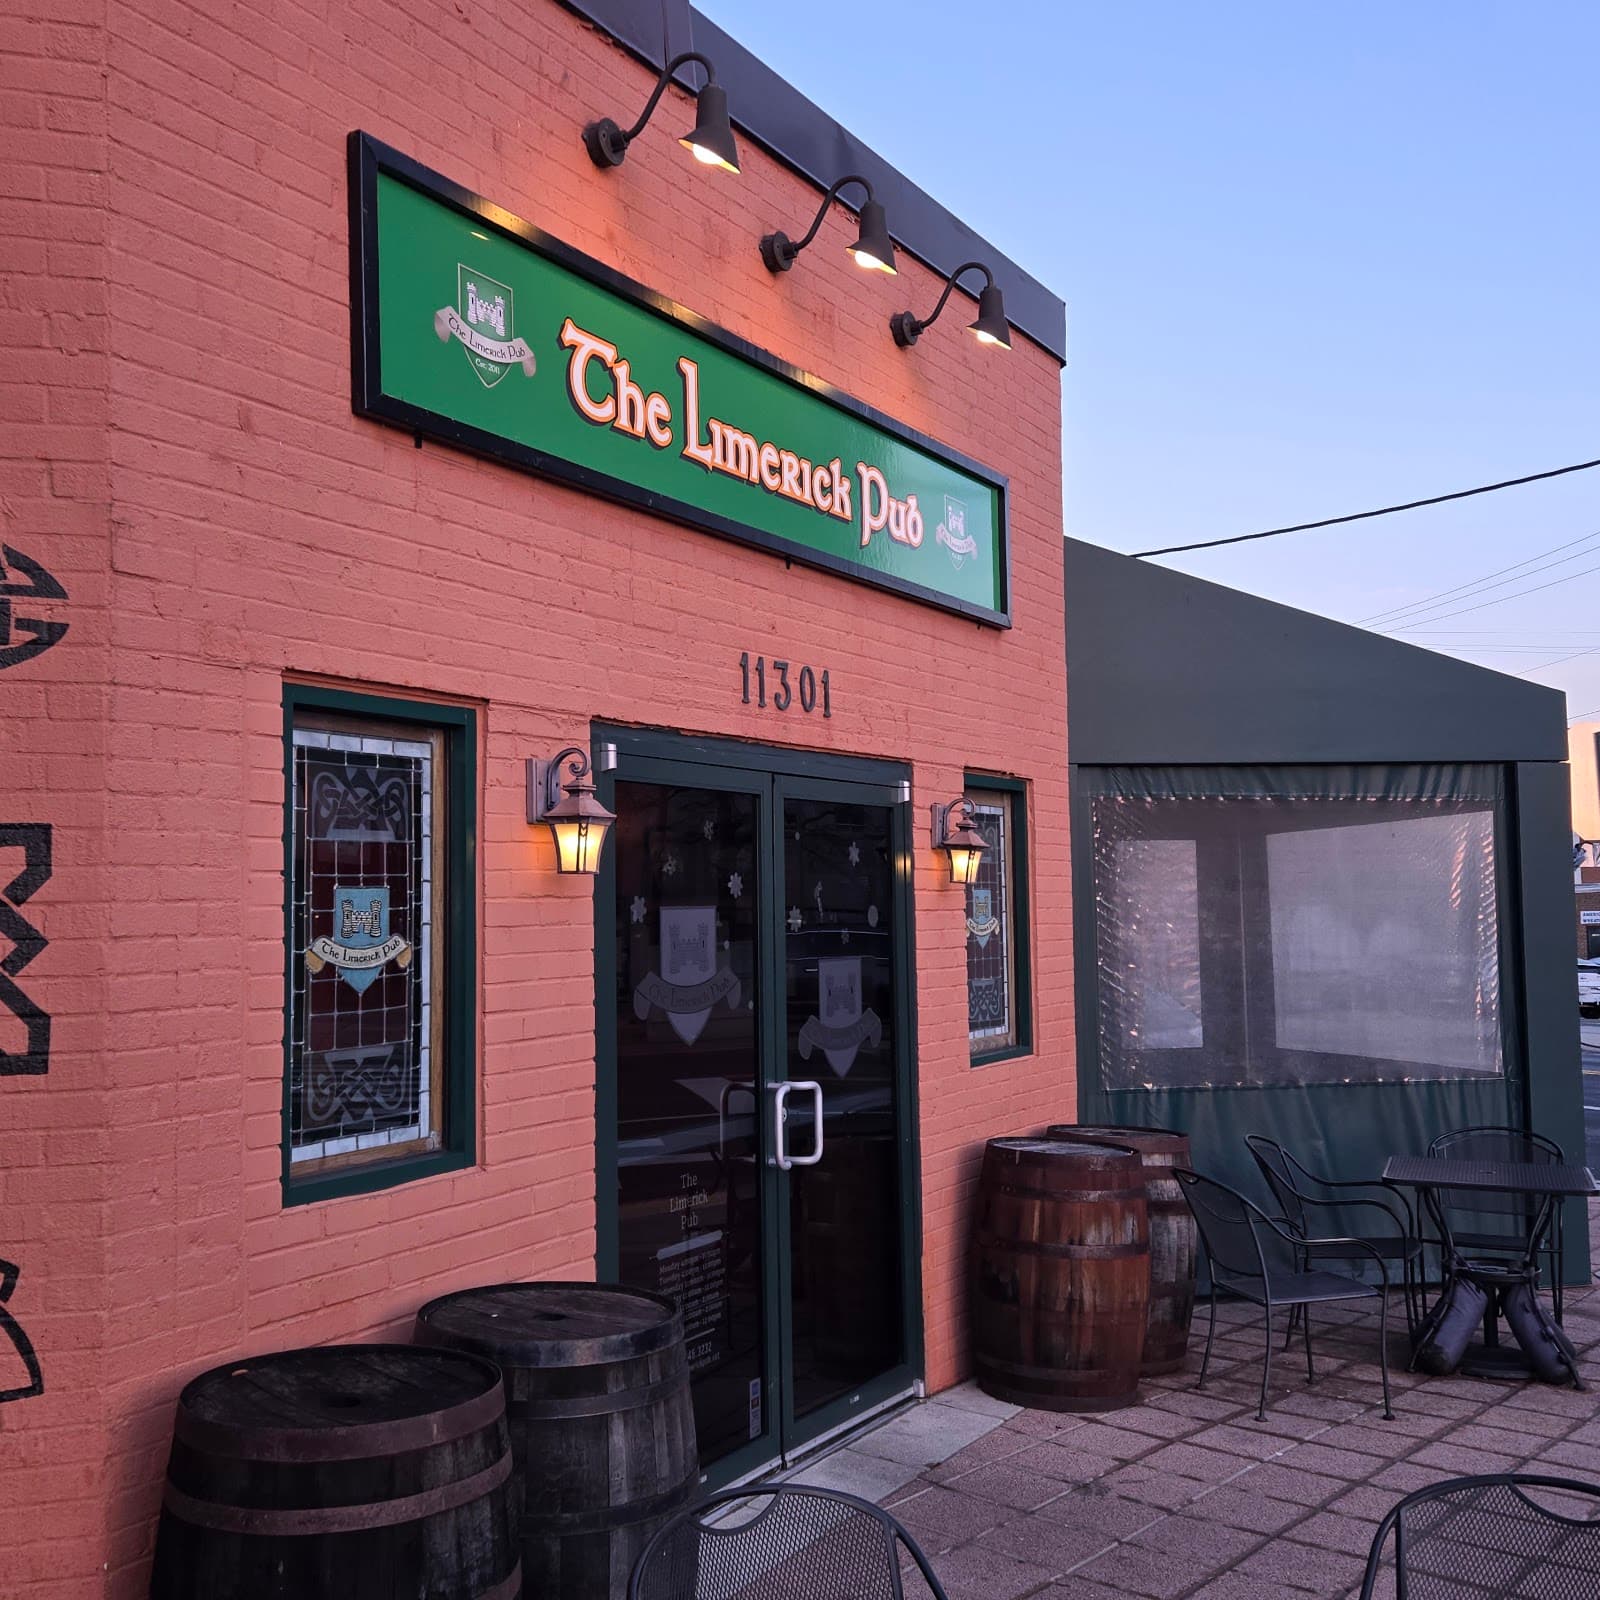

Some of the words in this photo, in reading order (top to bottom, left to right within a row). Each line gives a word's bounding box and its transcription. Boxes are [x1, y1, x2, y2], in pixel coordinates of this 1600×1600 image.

[448, 313, 466, 340] The
[469, 331, 507, 359] Limerick
[507, 345, 526, 360] Pub
[557, 316, 674, 449] The
[677, 356, 853, 523] Limerick
[856, 460, 925, 550] Pub
[739, 652, 832, 718] 11301
[321, 940, 340, 960] The
[343, 948, 381, 963] Limerick
[382, 938, 401, 958] Pub
[680, 1172, 698, 1189] The
[670, 1189, 709, 1213] Limerick
[681, 1211, 698, 1230] Pub
